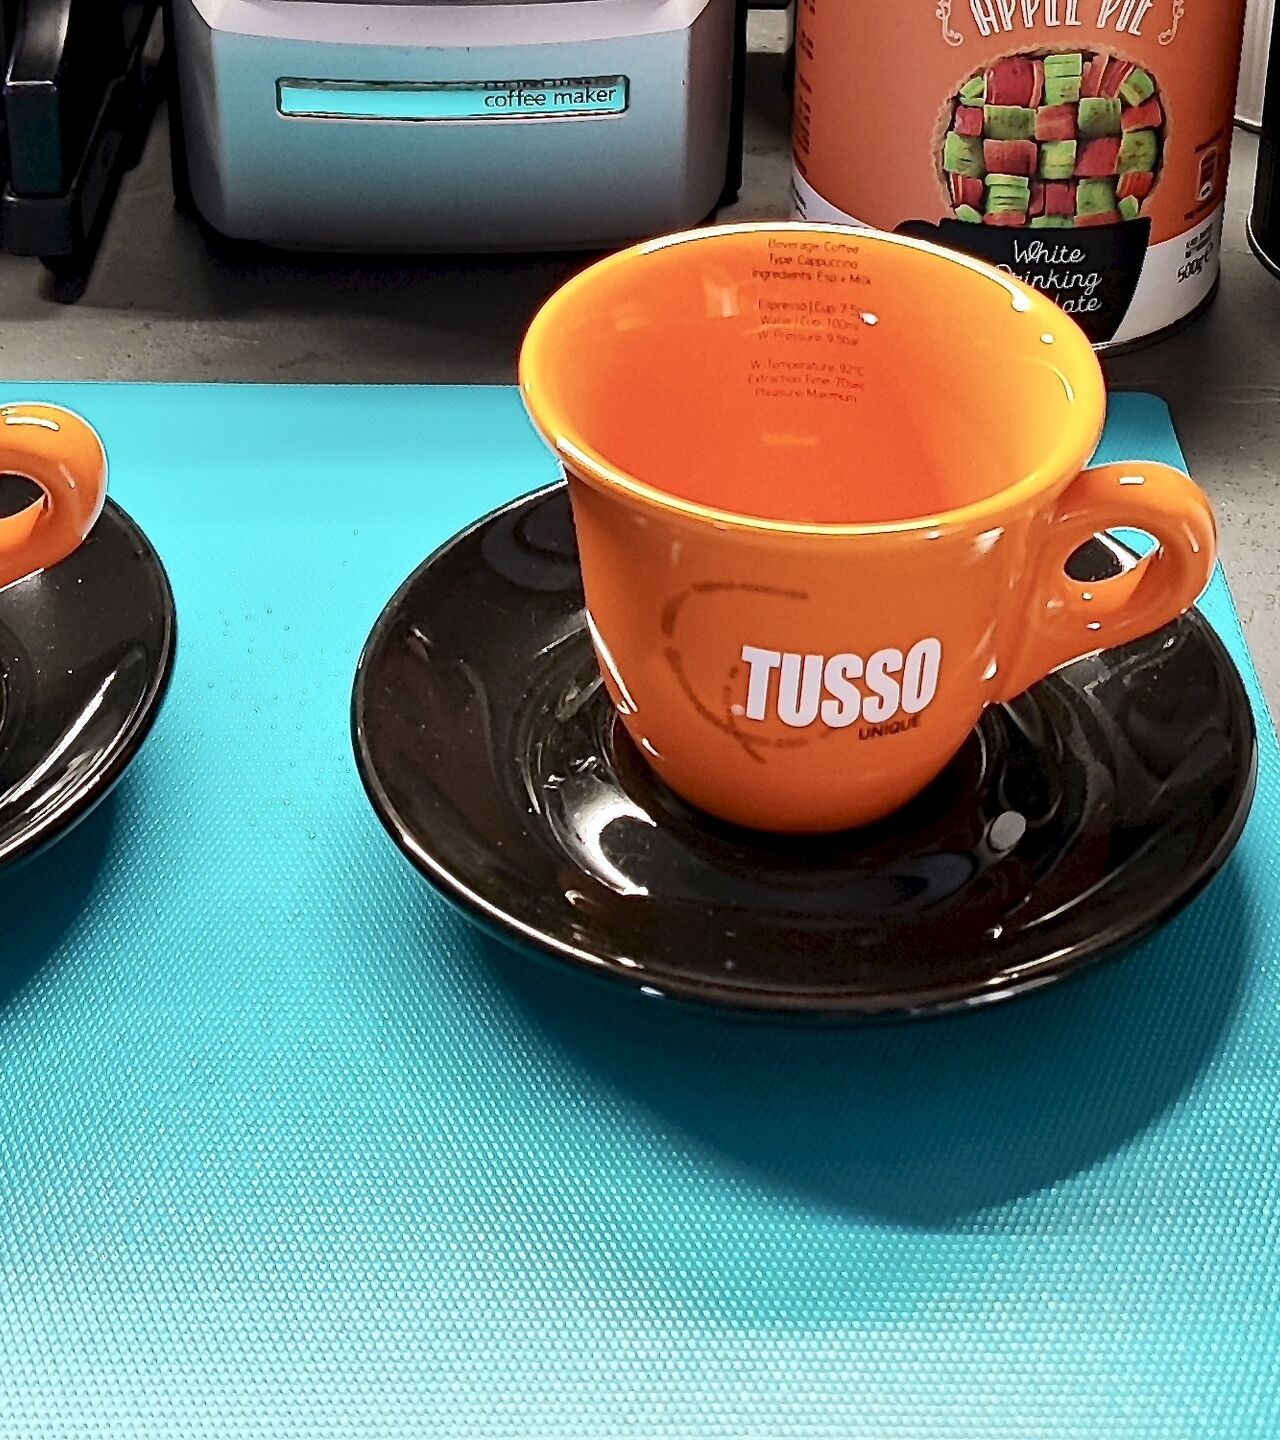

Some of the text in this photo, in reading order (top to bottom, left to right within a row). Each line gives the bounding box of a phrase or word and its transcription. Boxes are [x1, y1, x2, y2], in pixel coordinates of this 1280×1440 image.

[484, 85, 617, 107] coffee maker
[1014, 239, 1086, 264] White
[741, 637, 942, 728] TUSSO
[858, 714, 920, 740] UNIQUE
